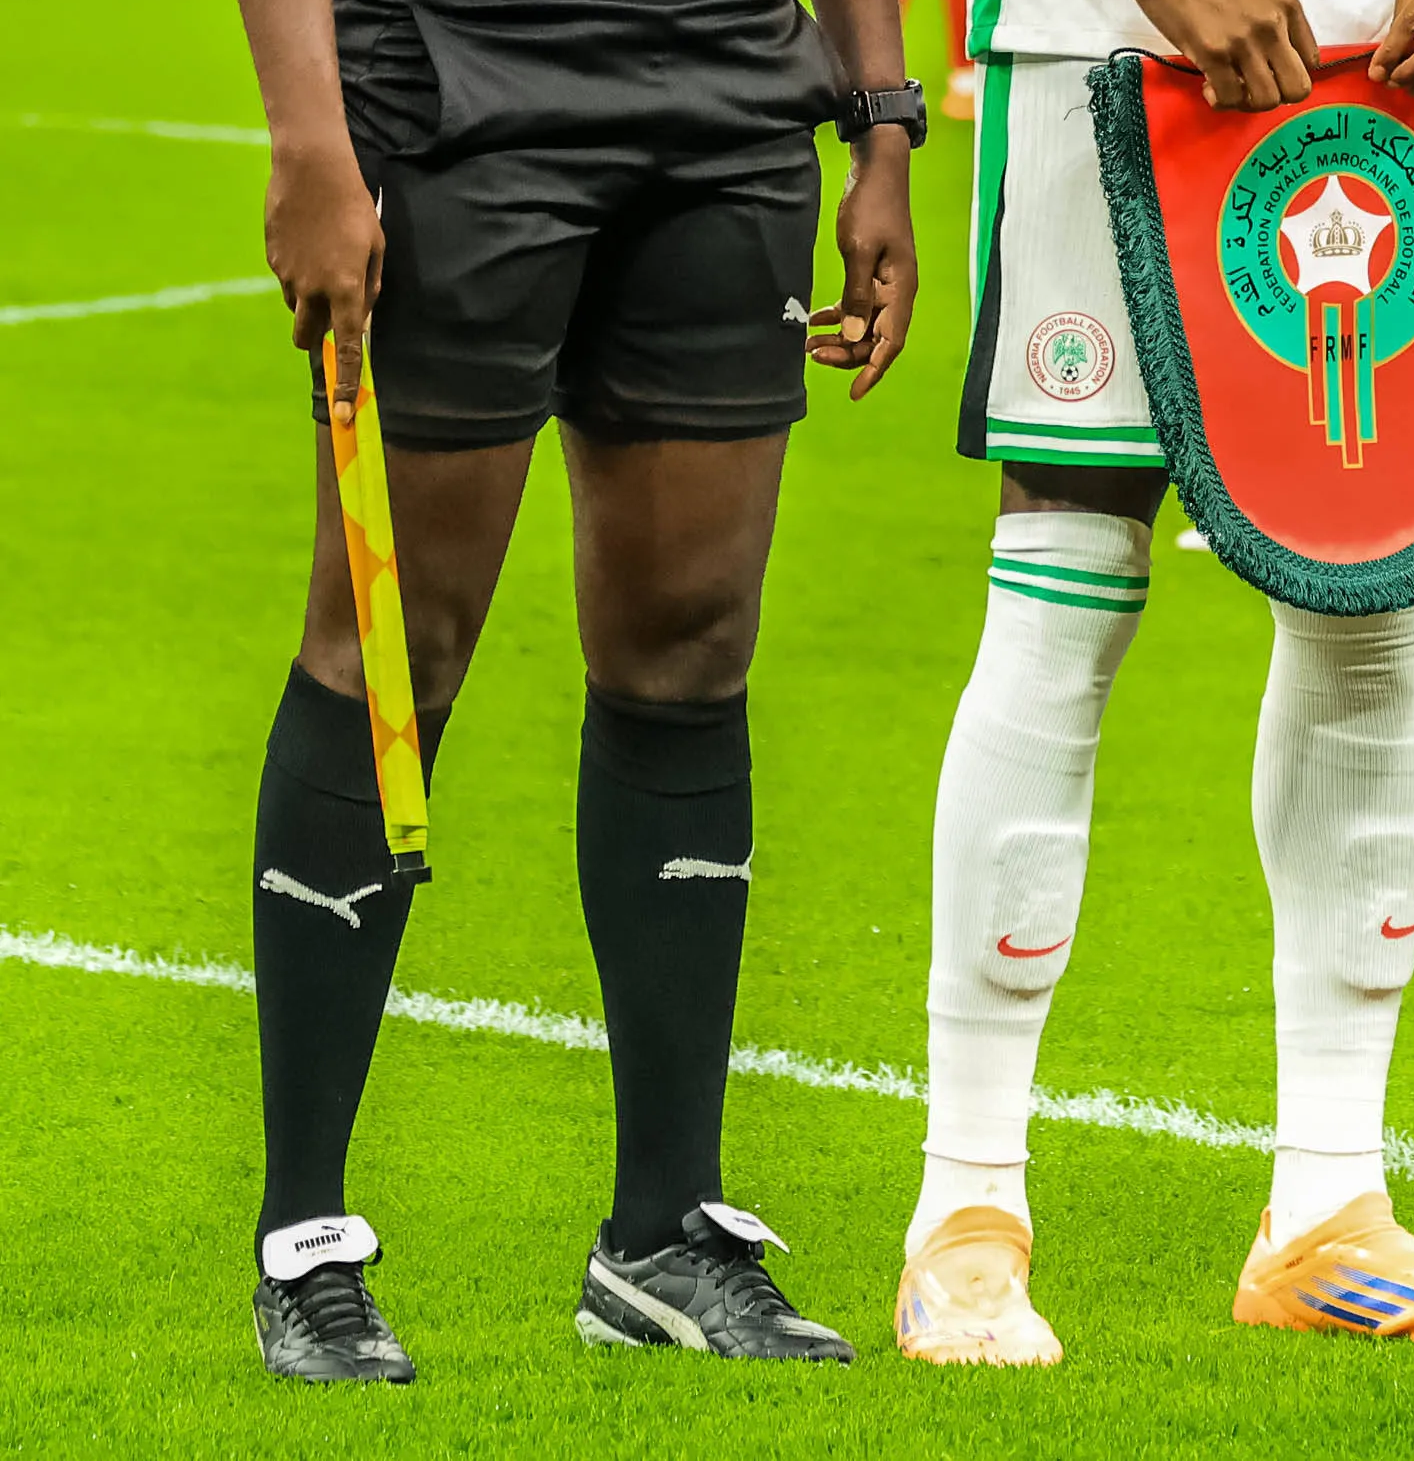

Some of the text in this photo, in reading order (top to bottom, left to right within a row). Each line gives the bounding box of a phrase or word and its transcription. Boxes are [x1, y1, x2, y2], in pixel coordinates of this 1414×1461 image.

[1250, 111, 1349, 179] المغربية
[1226, 184, 1257, 249] لكرة
[1257, 152, 1414, 314] FEDERATION ROYALE MAROCAINE DE FOOTBALL
[1031, 317, 1109, 385] NIGERIA FOOTBALL FEDERATION
[1059, 386, 1081, 395] 1945
